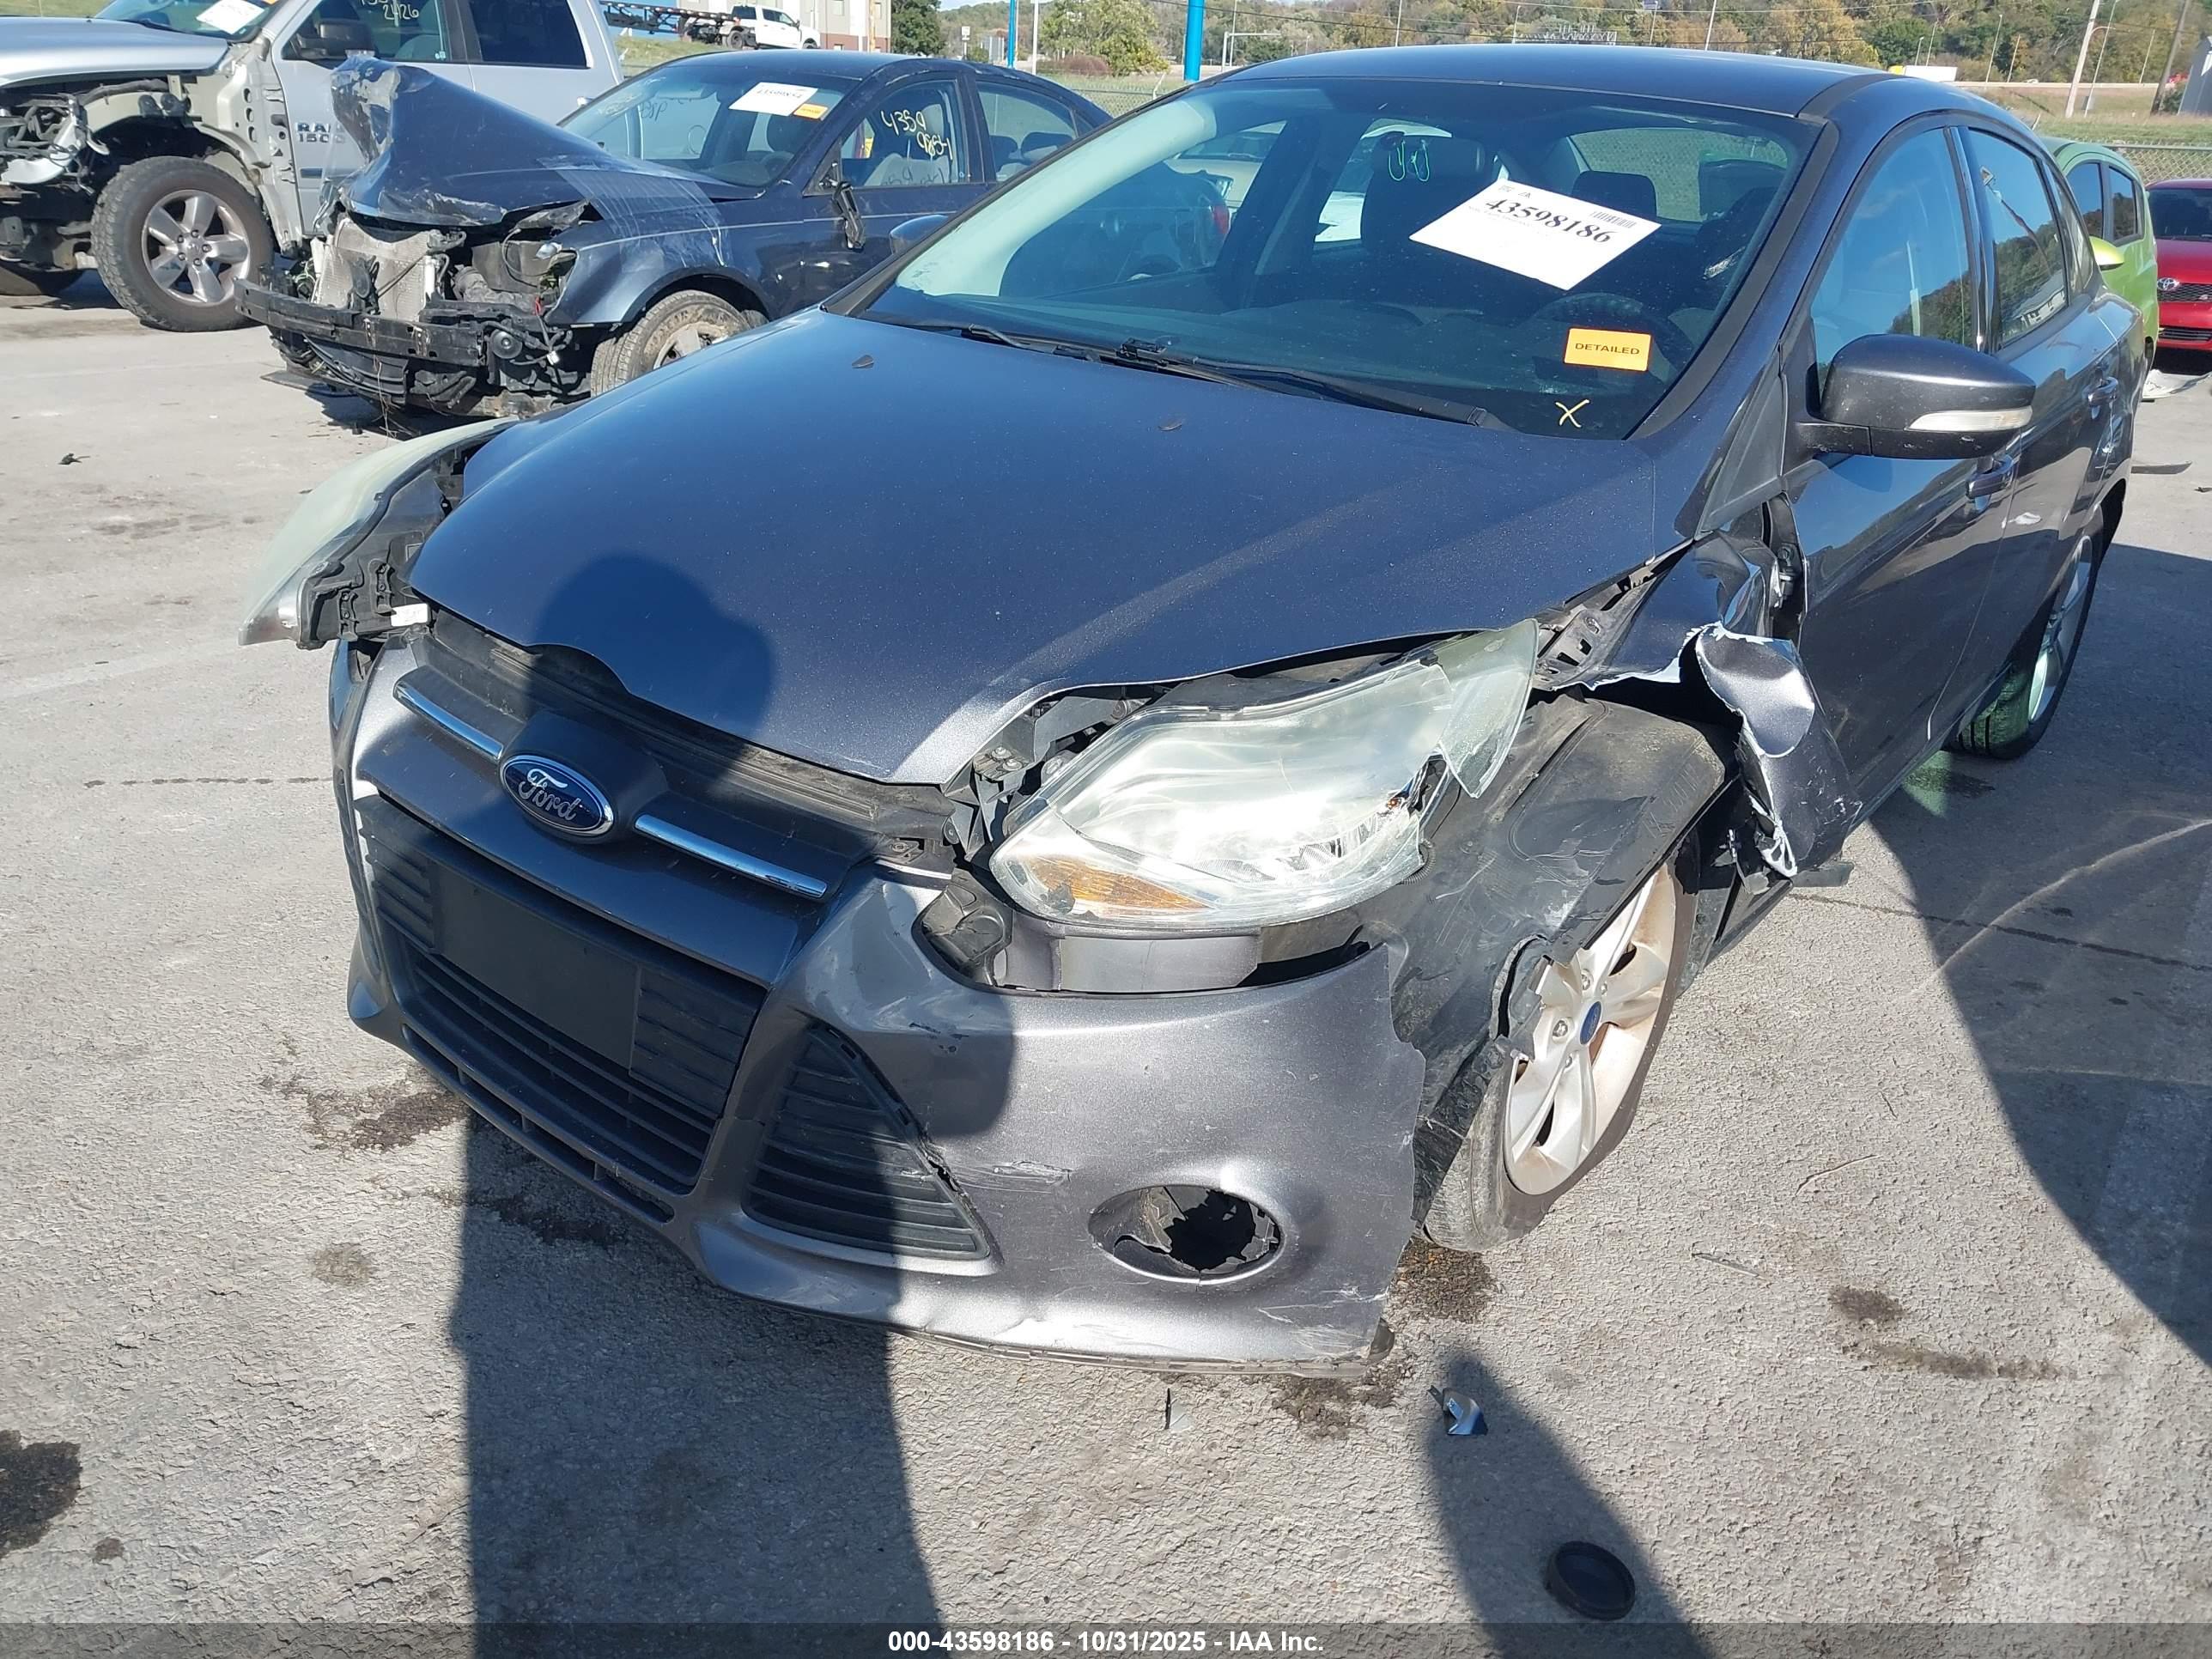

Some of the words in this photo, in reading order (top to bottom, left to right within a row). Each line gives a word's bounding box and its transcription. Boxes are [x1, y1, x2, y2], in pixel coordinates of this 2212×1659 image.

[880, 109, 927, 136] 4359
[1485, 198, 1620, 243] 43598186
[1575, 342, 1641, 356] DETAILED
[518, 768, 582, 821] Ford
